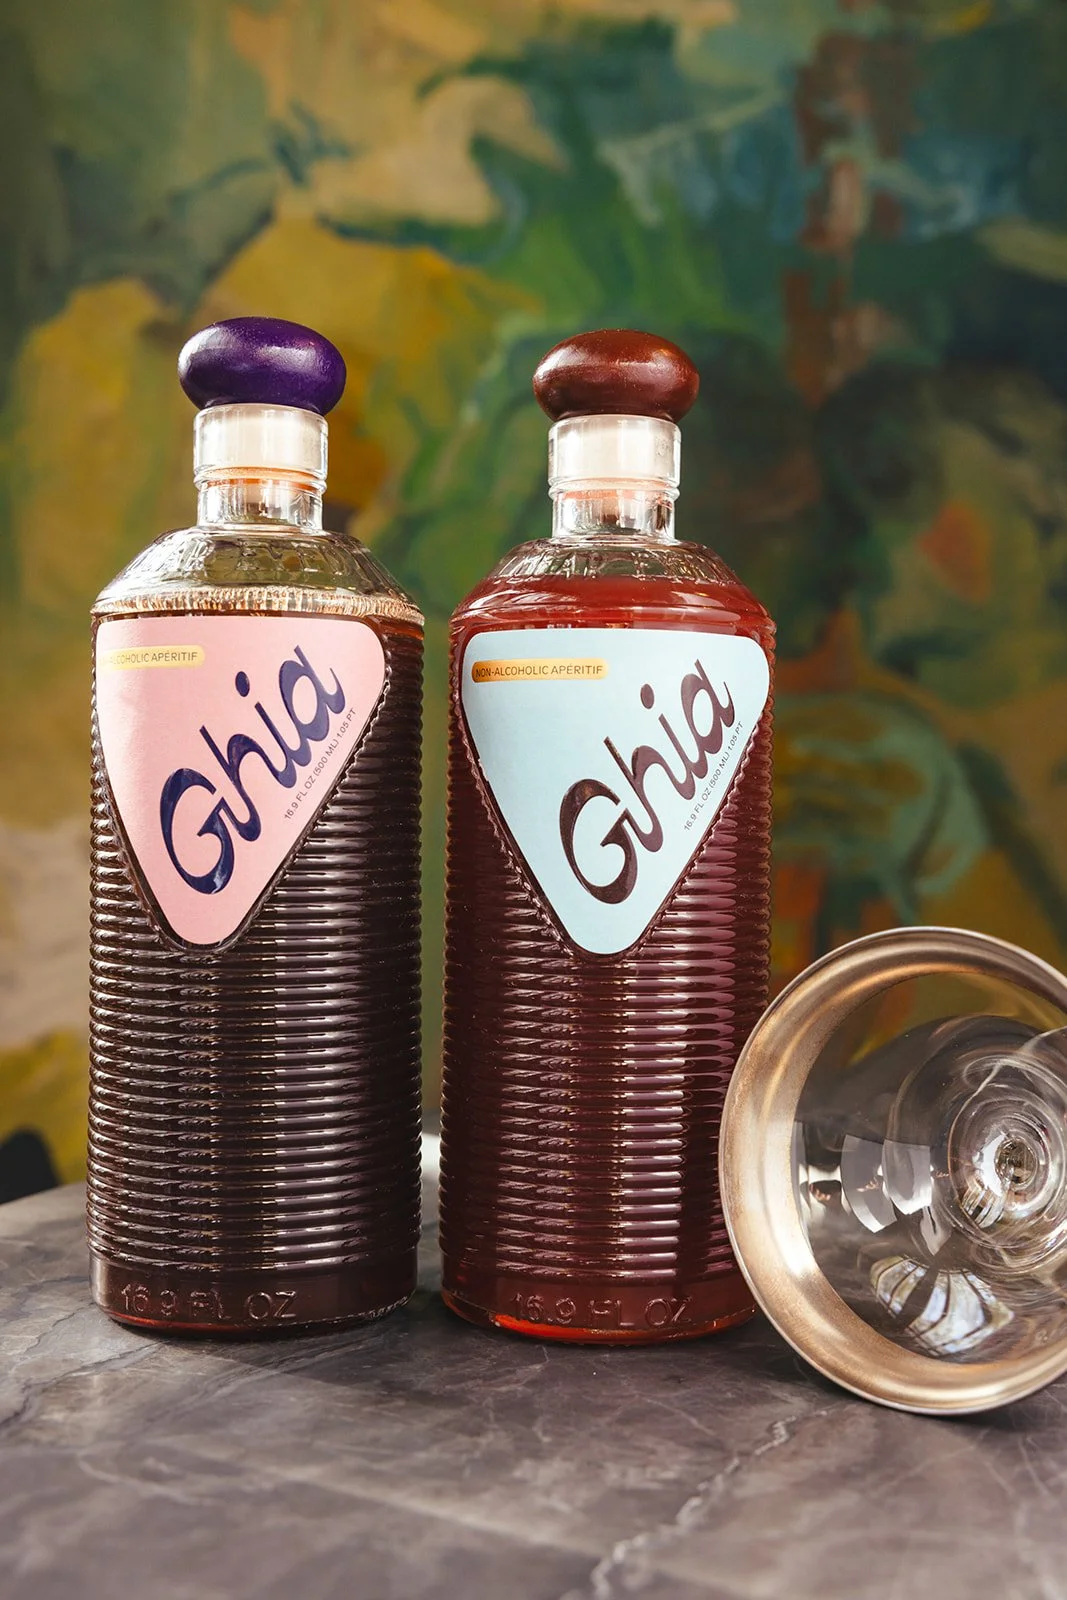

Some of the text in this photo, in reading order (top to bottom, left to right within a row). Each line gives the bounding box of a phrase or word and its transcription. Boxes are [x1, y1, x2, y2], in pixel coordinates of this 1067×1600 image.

[151, 650, 198, 662] APÉRITIF
[475, 663, 603, 678] NON-ALCOHOLIC APÉRITIF
[160, 645, 346, 895] Ghia
[284, 708, 357, 820] 16.9 FL OZ (500 ML) 1.05 PT
[559, 659, 735, 905] Ghia
[683, 721, 745, 832] 16.9 FL OZ (500 ML) 1.05 PT
[121, 1284, 177, 1316] 169
[245, 1290, 297, 1320] OZ
[644, 1295, 695, 1328] OZ
